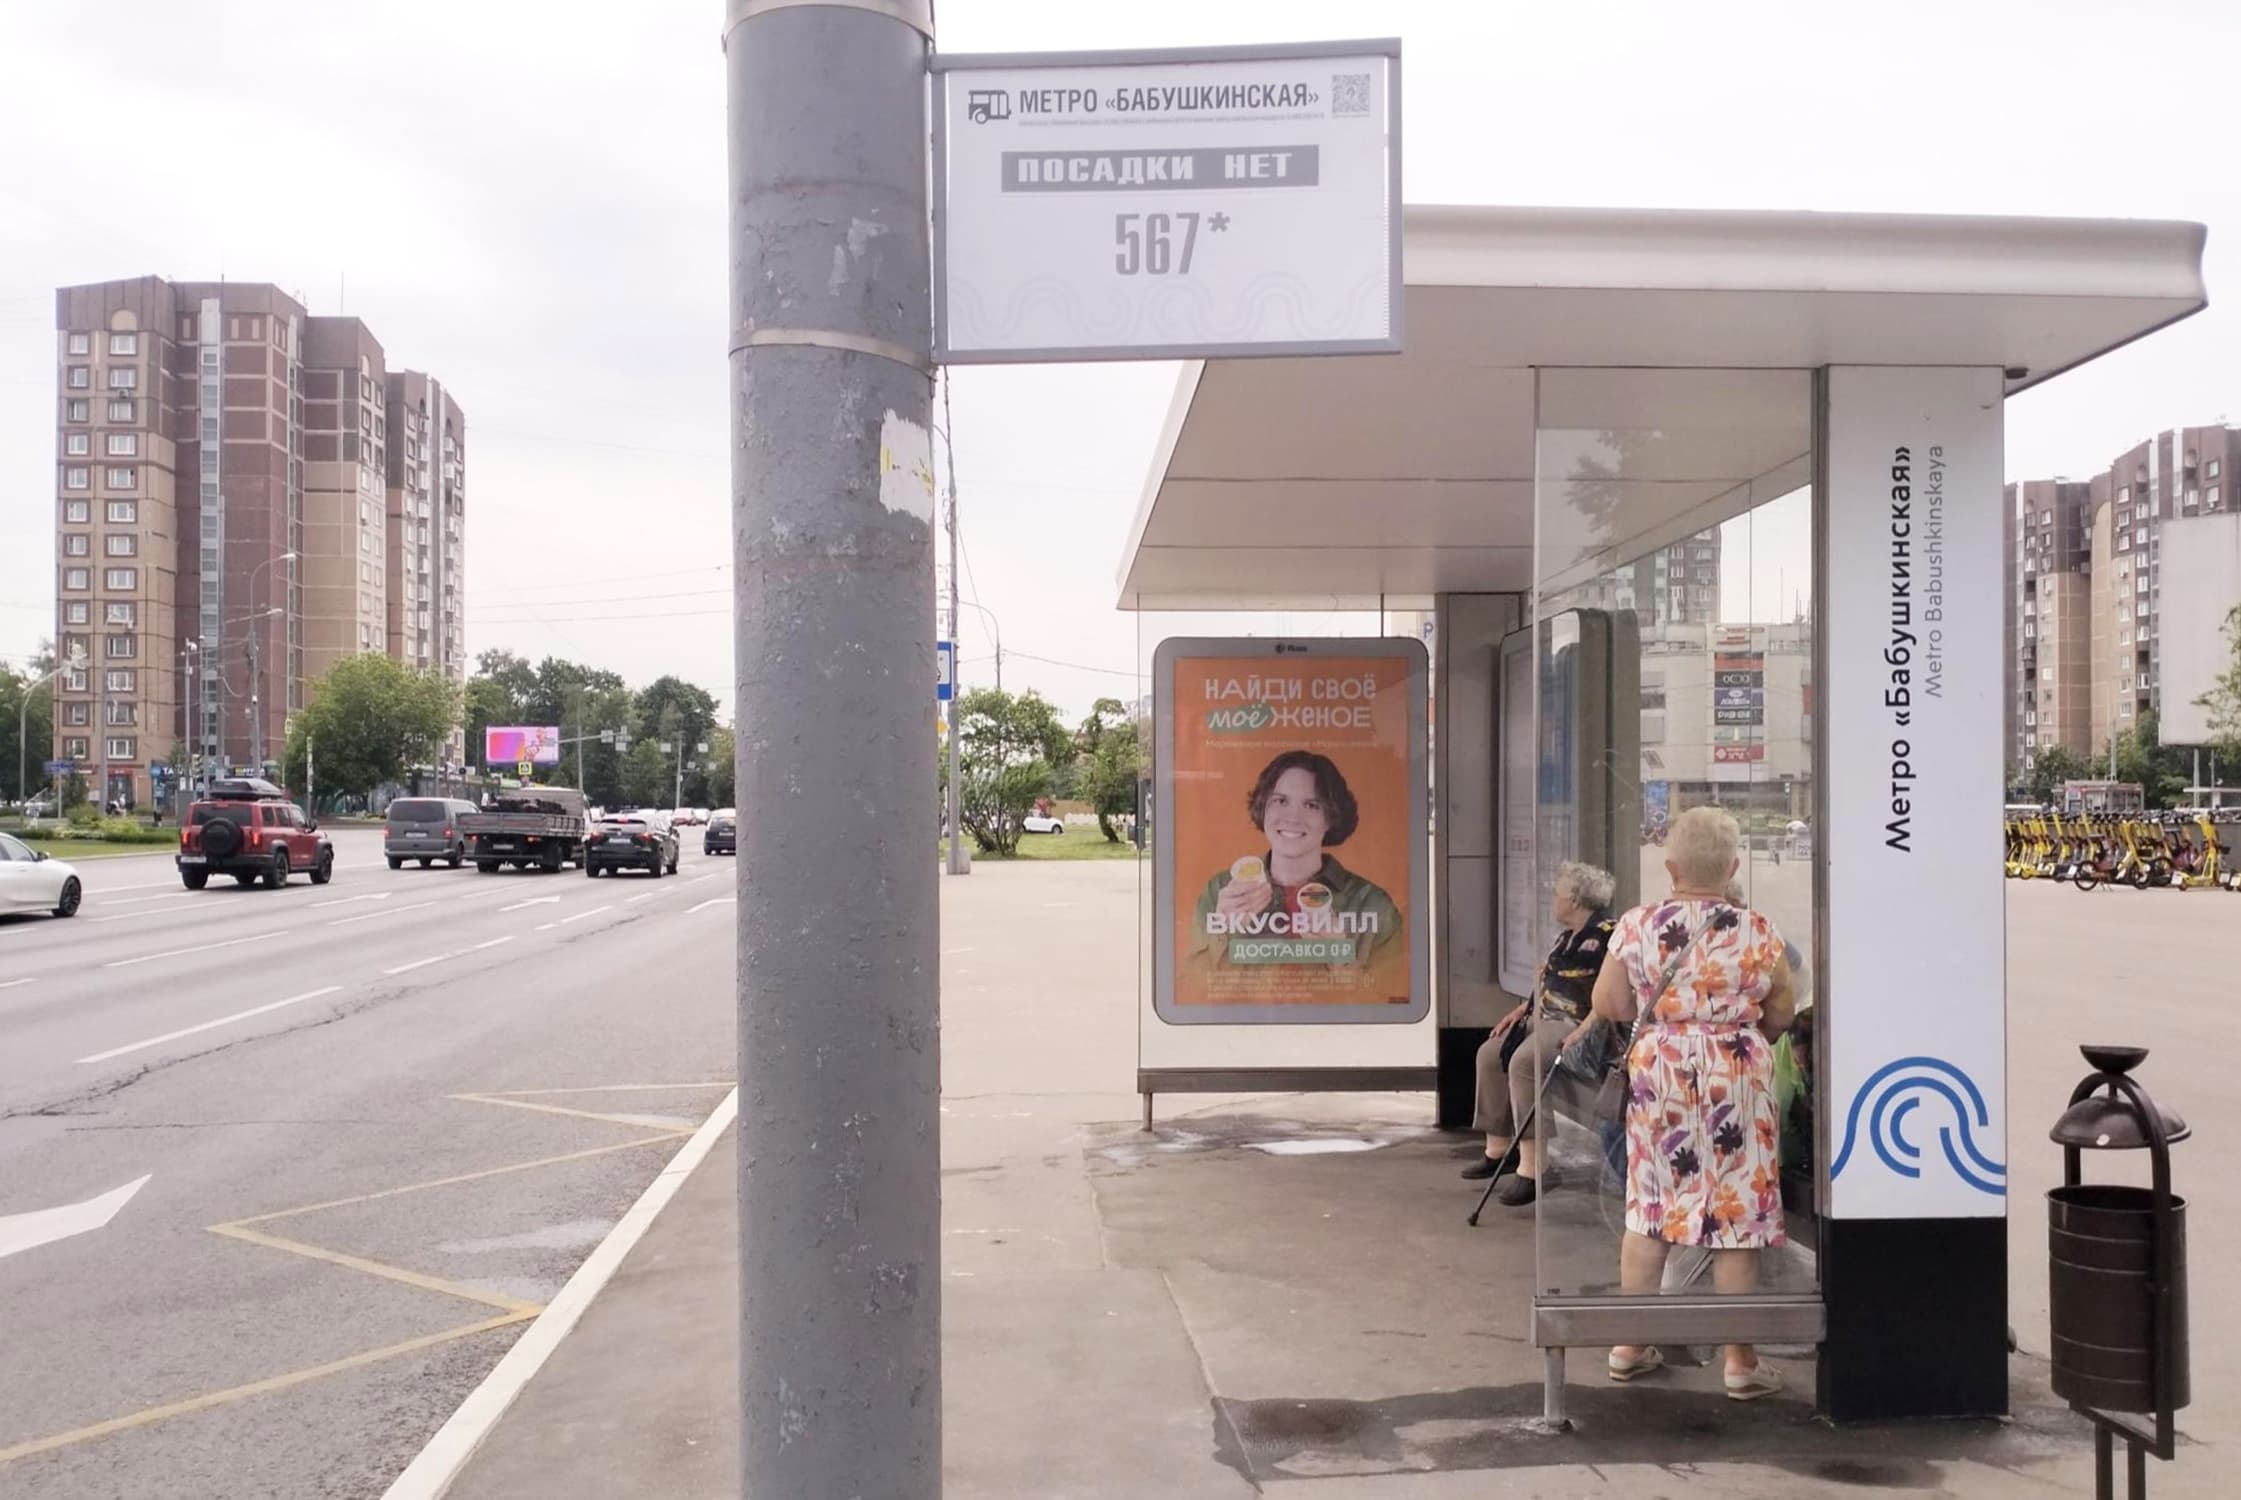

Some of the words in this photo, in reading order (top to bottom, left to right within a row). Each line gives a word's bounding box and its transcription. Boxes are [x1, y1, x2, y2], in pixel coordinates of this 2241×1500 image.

[1019, 87, 1098, 114] МЕТРО
[1106, 83, 1319, 112] «БАБУШКИНСКАЯ»
[1018, 155, 1194, 185] ПОСАДКИ
[1224, 152, 1293, 179] НЕТ
[1924, 445, 1946, 621] Babushkinskaya
[1884, 446, 1917, 726] «Бабушкинская»
[1205, 674, 1303, 703] НАЙДИ
[1924, 629, 1943, 698] Metro
[1885, 739, 1916, 853] Метро
[1206, 911, 1379, 934] ВКУСВИЛЛ
